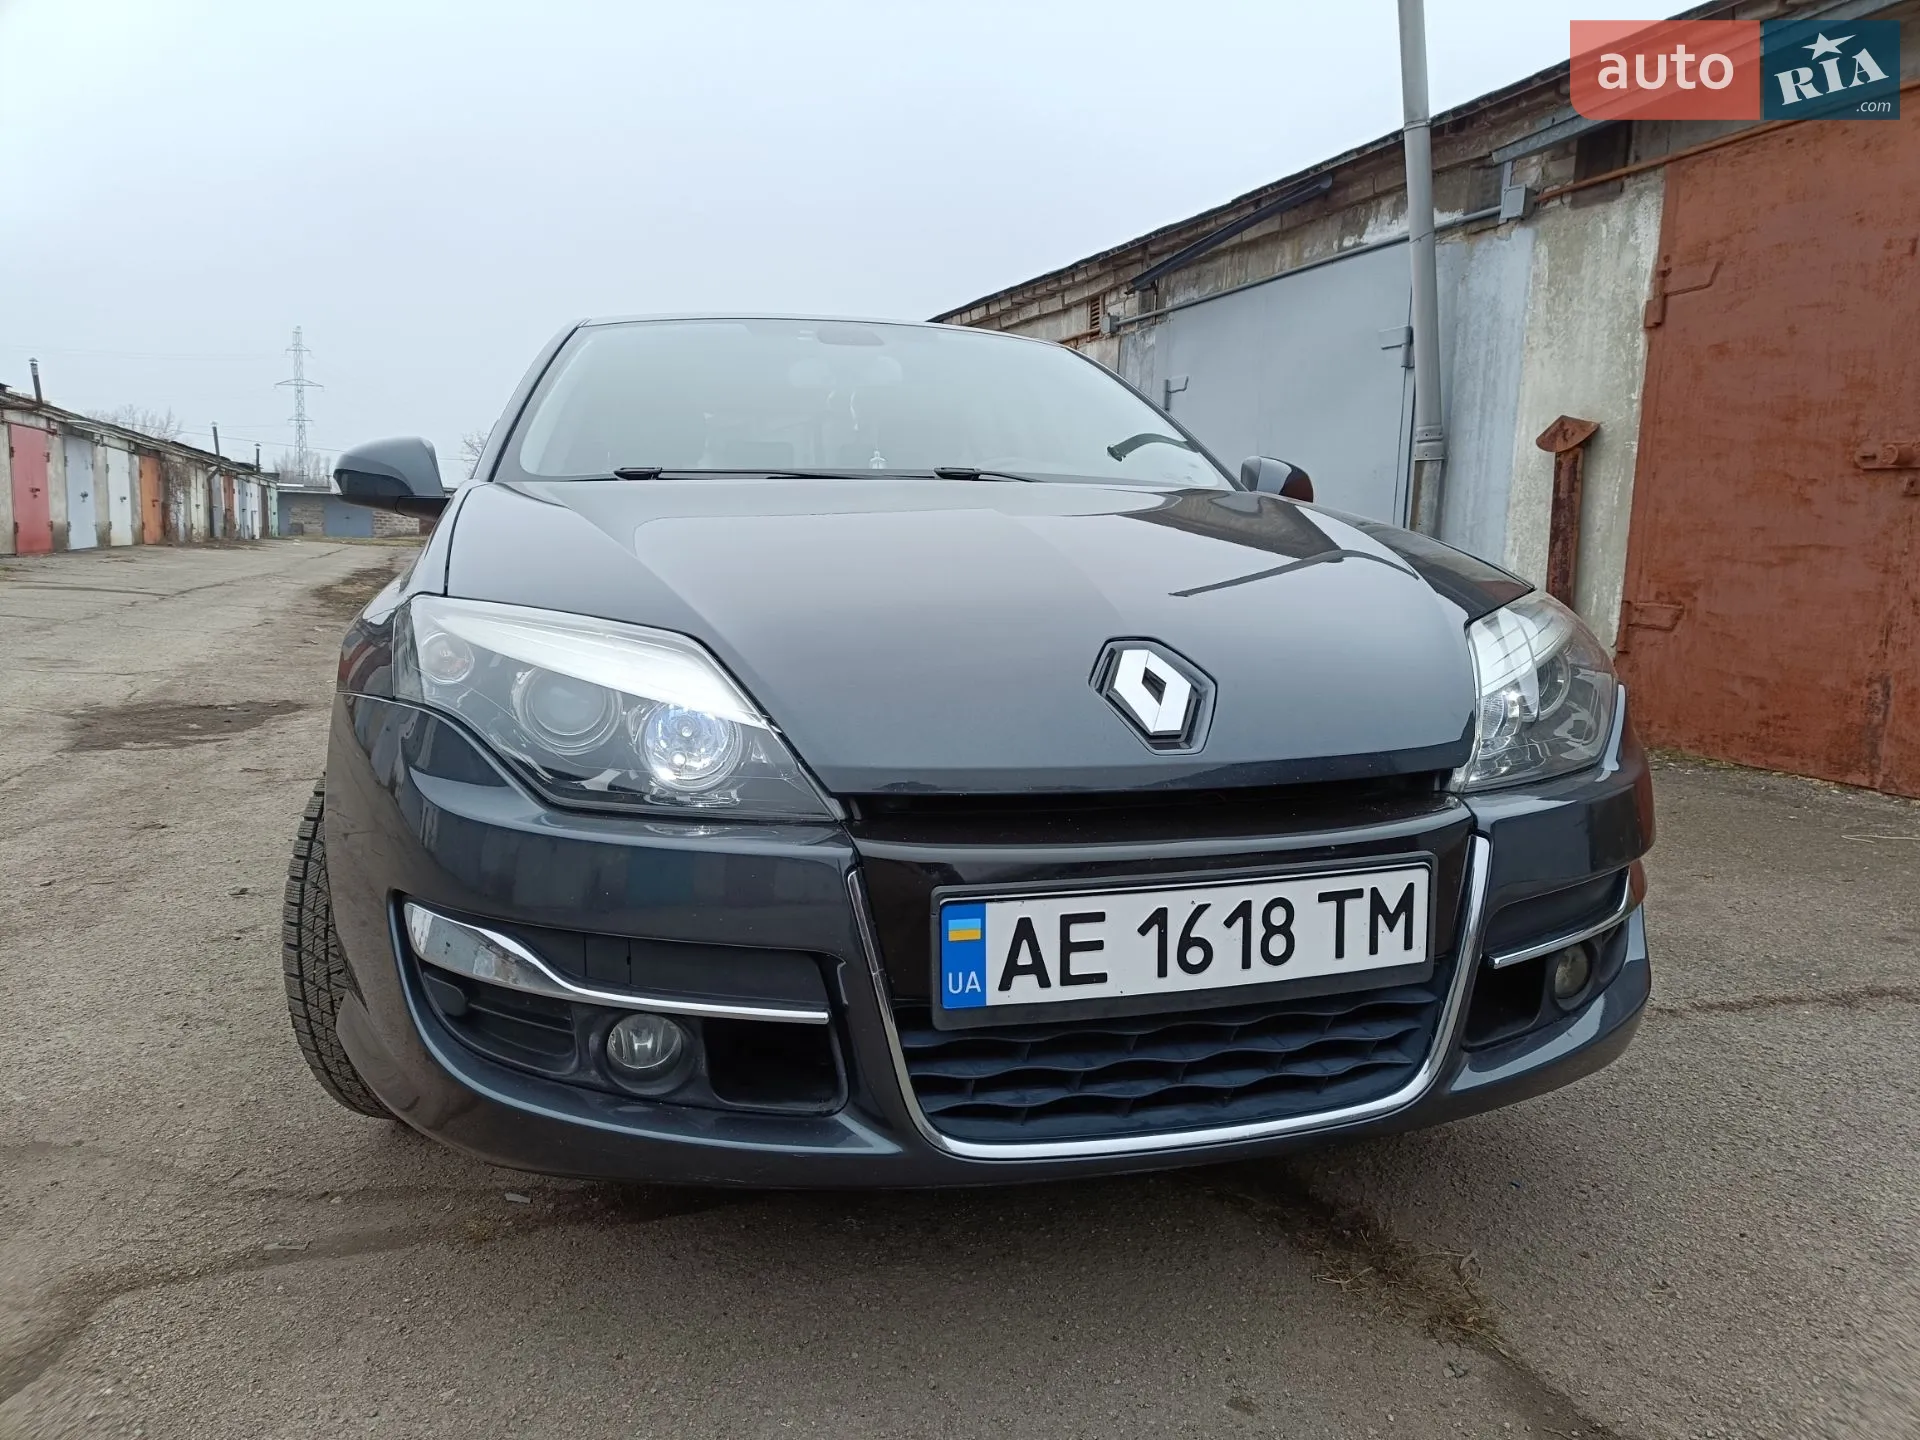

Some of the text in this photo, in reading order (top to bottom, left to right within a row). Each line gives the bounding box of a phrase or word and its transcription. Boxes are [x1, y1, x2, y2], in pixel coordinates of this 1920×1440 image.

[997, 881, 1415, 992] AE 1618 TM
[948, 971, 982, 994] UA
